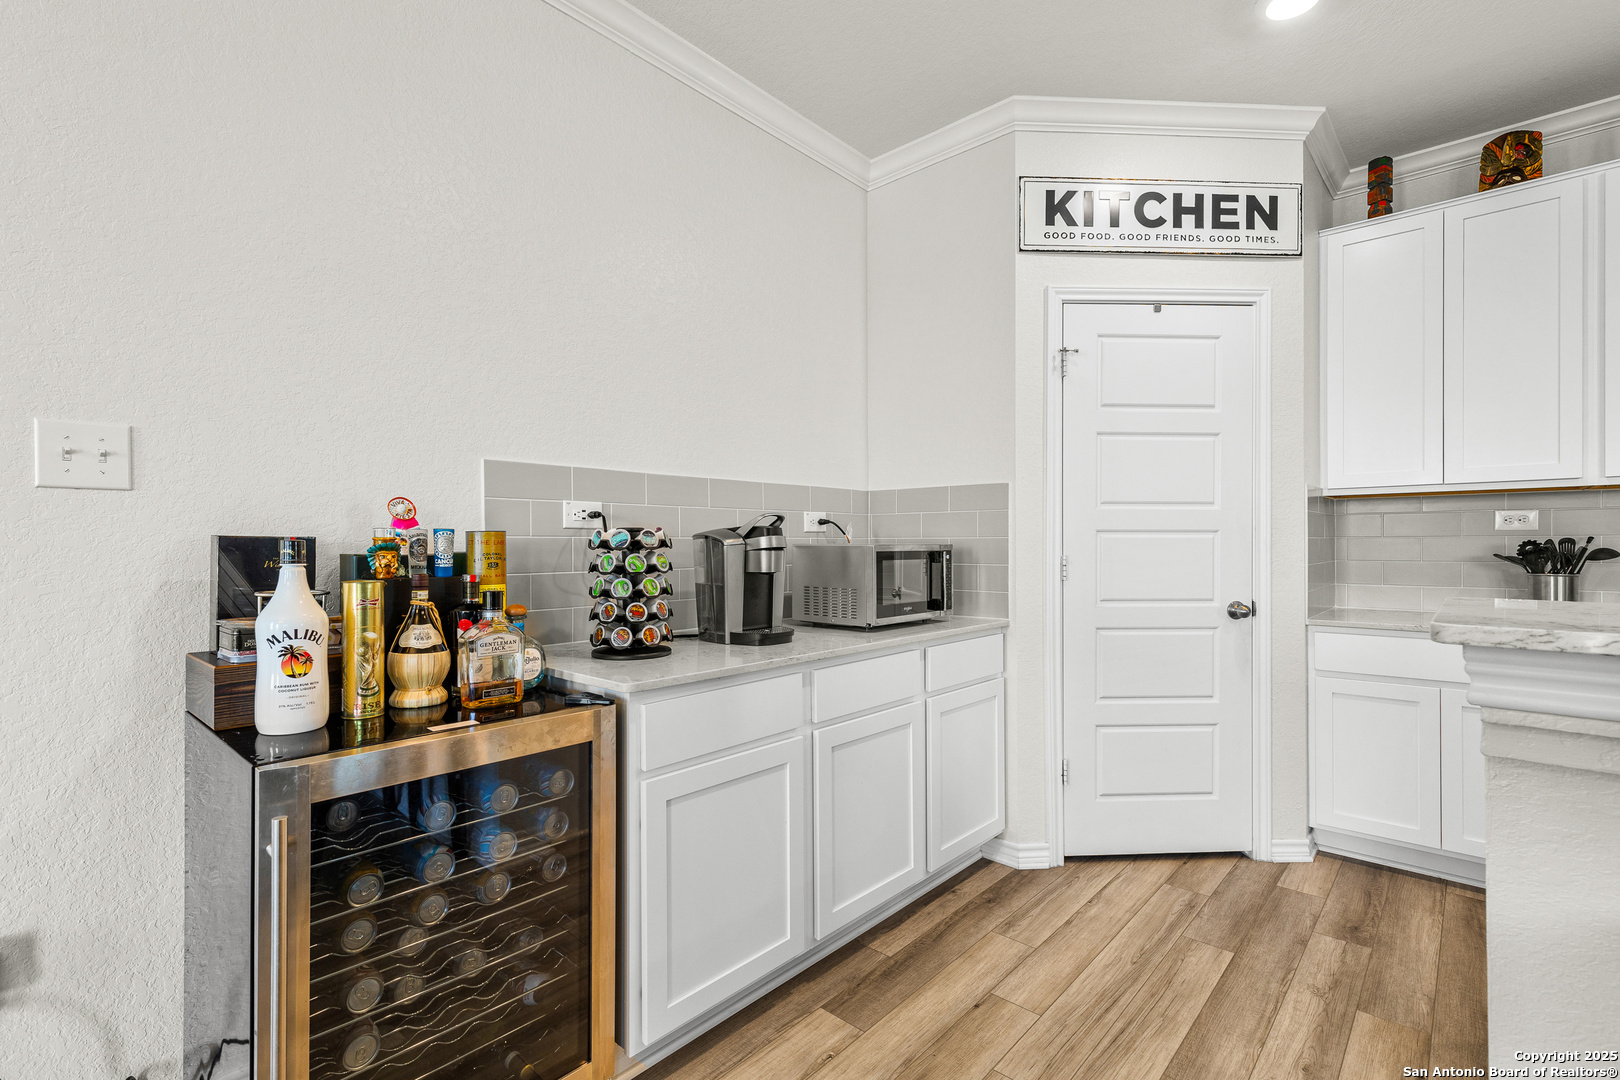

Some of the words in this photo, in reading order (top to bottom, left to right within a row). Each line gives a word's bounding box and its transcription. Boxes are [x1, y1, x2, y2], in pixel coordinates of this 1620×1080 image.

[1045, 189, 1278, 231] KITCHEN
[1044, 232, 1076, 240] GOOD
[1080, 232, 1115, 241] FOOD.
[1119, 233, 1151, 241] GOOD
[1155, 234, 1205, 243] FRIENDS.
[1209, 235, 1241, 243] GOOD
[1245, 235, 1279, 244] TIMES.
[266, 629, 325, 649] MALIBU
[480, 639, 517, 648] GENTLEMAN
